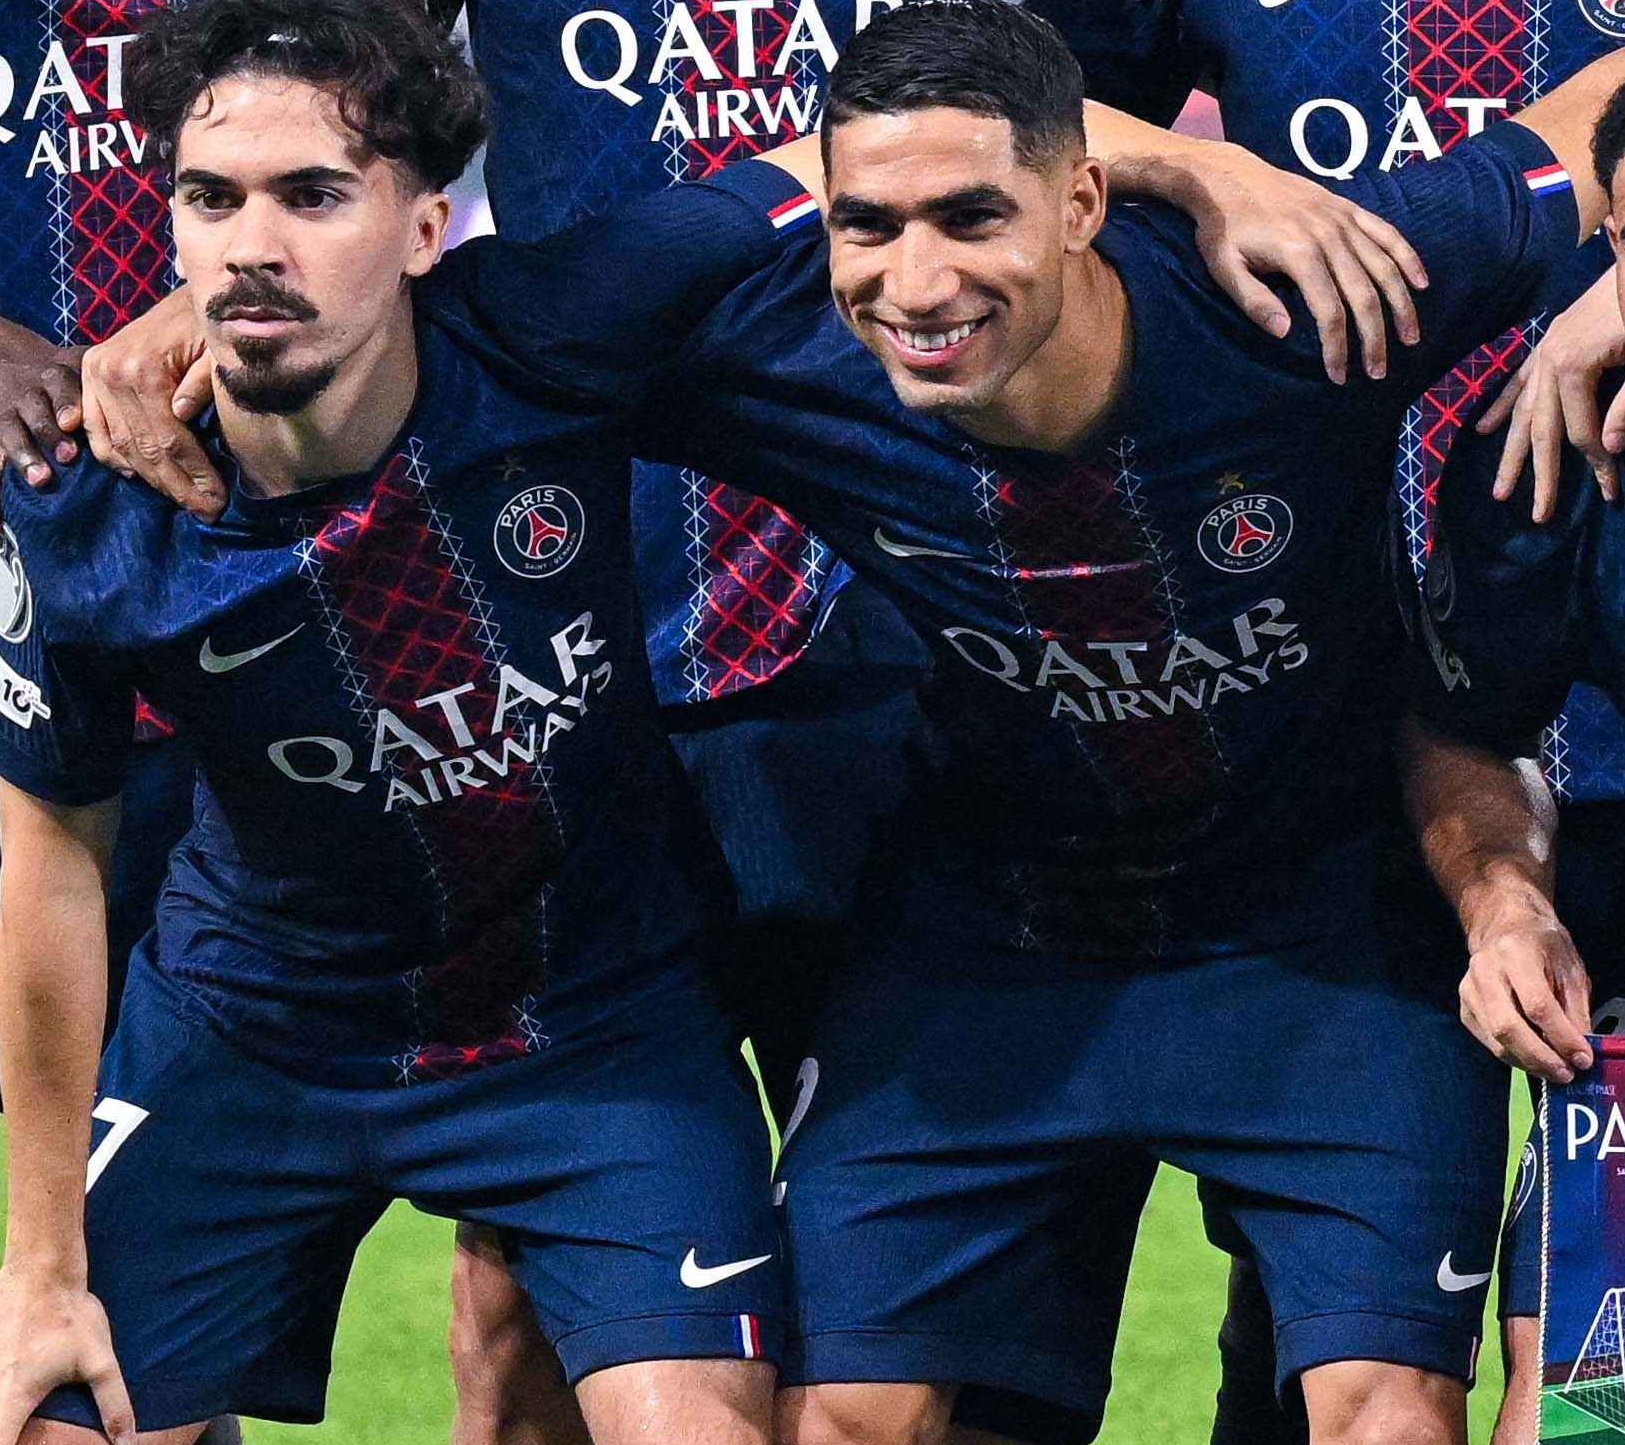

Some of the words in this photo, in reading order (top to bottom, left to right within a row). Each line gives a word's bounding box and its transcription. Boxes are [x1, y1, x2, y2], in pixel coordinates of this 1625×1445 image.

[650, 84, 823, 142] AIRW
[1289, 95, 1507, 181] QAT
[500, 489, 556, 528] PARIS
[1206, 498, 1269, 527] PARIS
[939, 597, 1300, 693] QATAR
[1049, 632, 1309, 723] AIRWAYS
[2, 677, 32, 713] 10
[267, 610, 607, 795] QATAR
[383, 660, 613, 813] AIRWAYS
